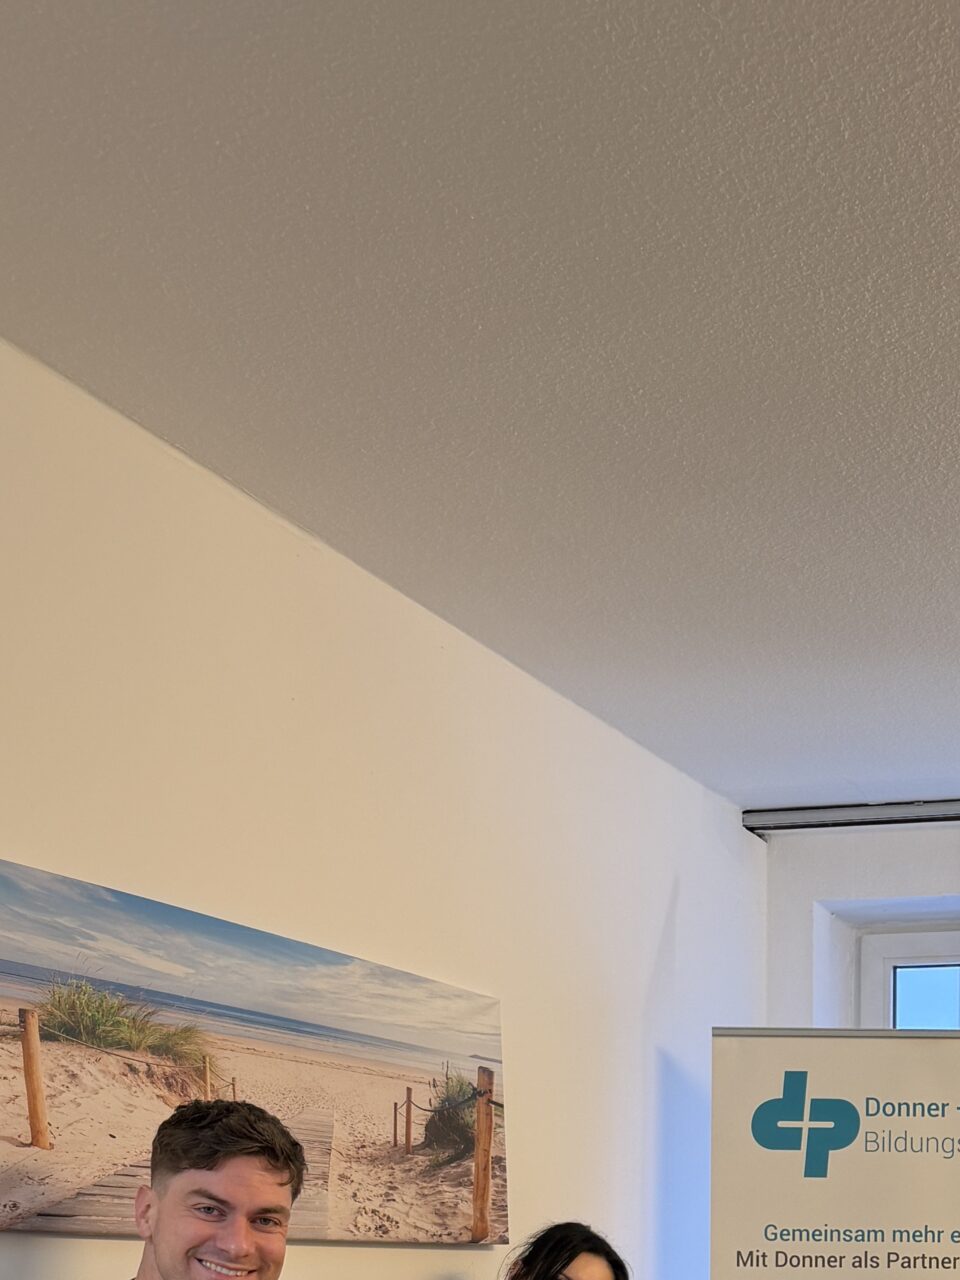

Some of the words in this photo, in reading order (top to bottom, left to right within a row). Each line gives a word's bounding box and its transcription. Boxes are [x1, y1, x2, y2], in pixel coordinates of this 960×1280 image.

[865, 1097, 949, 1118] Donner
[763, 1223, 885, 1243] Gemeinsam
[892, 1224, 945, 1244] mehr
[736, 1249, 769, 1268] Mit
[774, 1250, 847, 1269] Donner
[851, 1250, 880, 1269] als
[886, 1251, 960, 1270] Partner
